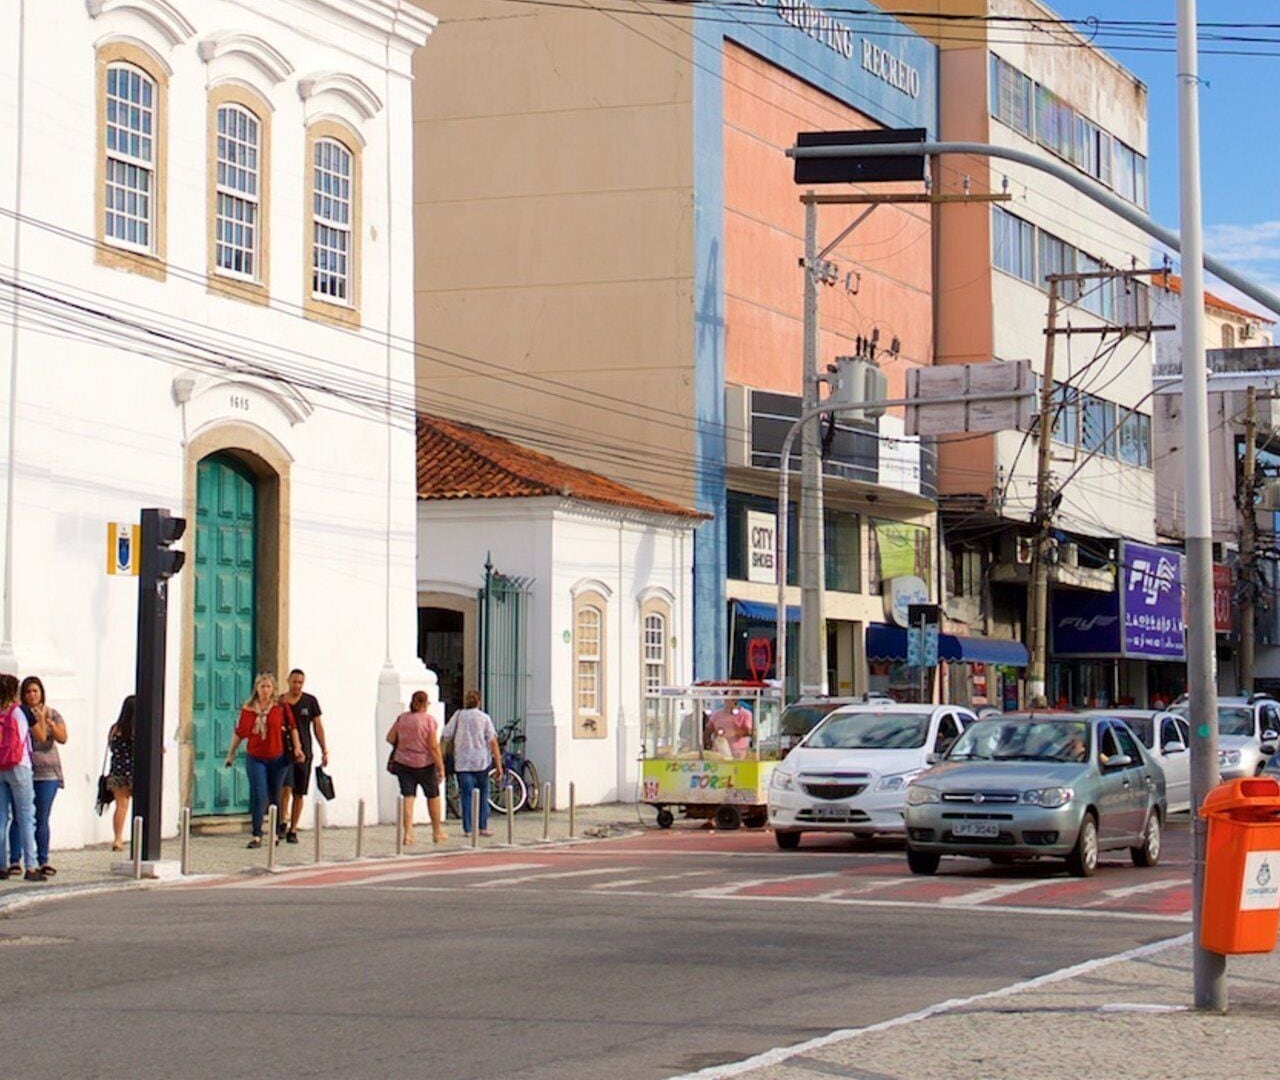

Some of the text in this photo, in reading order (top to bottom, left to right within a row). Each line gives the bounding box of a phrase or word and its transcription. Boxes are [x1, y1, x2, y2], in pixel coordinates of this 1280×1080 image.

[860, 37, 920, 100] RECREIO
[229, 395, 250, 412] 1615
[751, 526, 774, 551] CITY
[751, 551, 775, 569] SHOES
[1128, 557, 1171, 606] Fly
